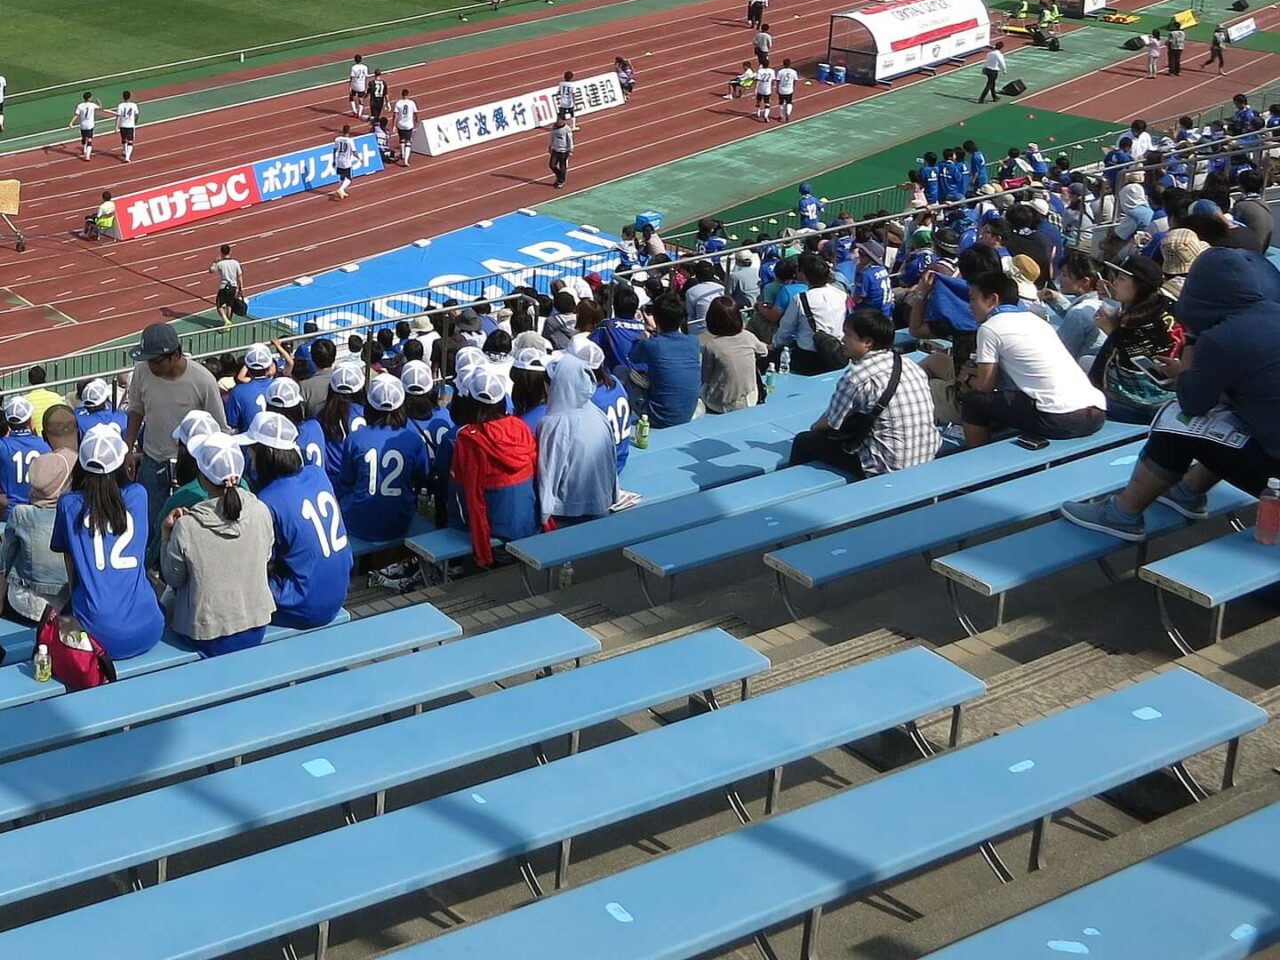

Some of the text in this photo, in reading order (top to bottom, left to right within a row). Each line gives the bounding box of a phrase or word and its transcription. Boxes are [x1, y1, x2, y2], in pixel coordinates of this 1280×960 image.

[402, 104, 408, 115] 8
[456, 101, 527, 141] 阿波銀行
[127, 172, 250, 230] オロナミンC
[806, 203, 817, 220] 12
[606, 396, 631, 445] 12
[364, 447, 404, 497] 12
[83, 510, 138, 571] 12
[302, 490, 348, 559] 12
